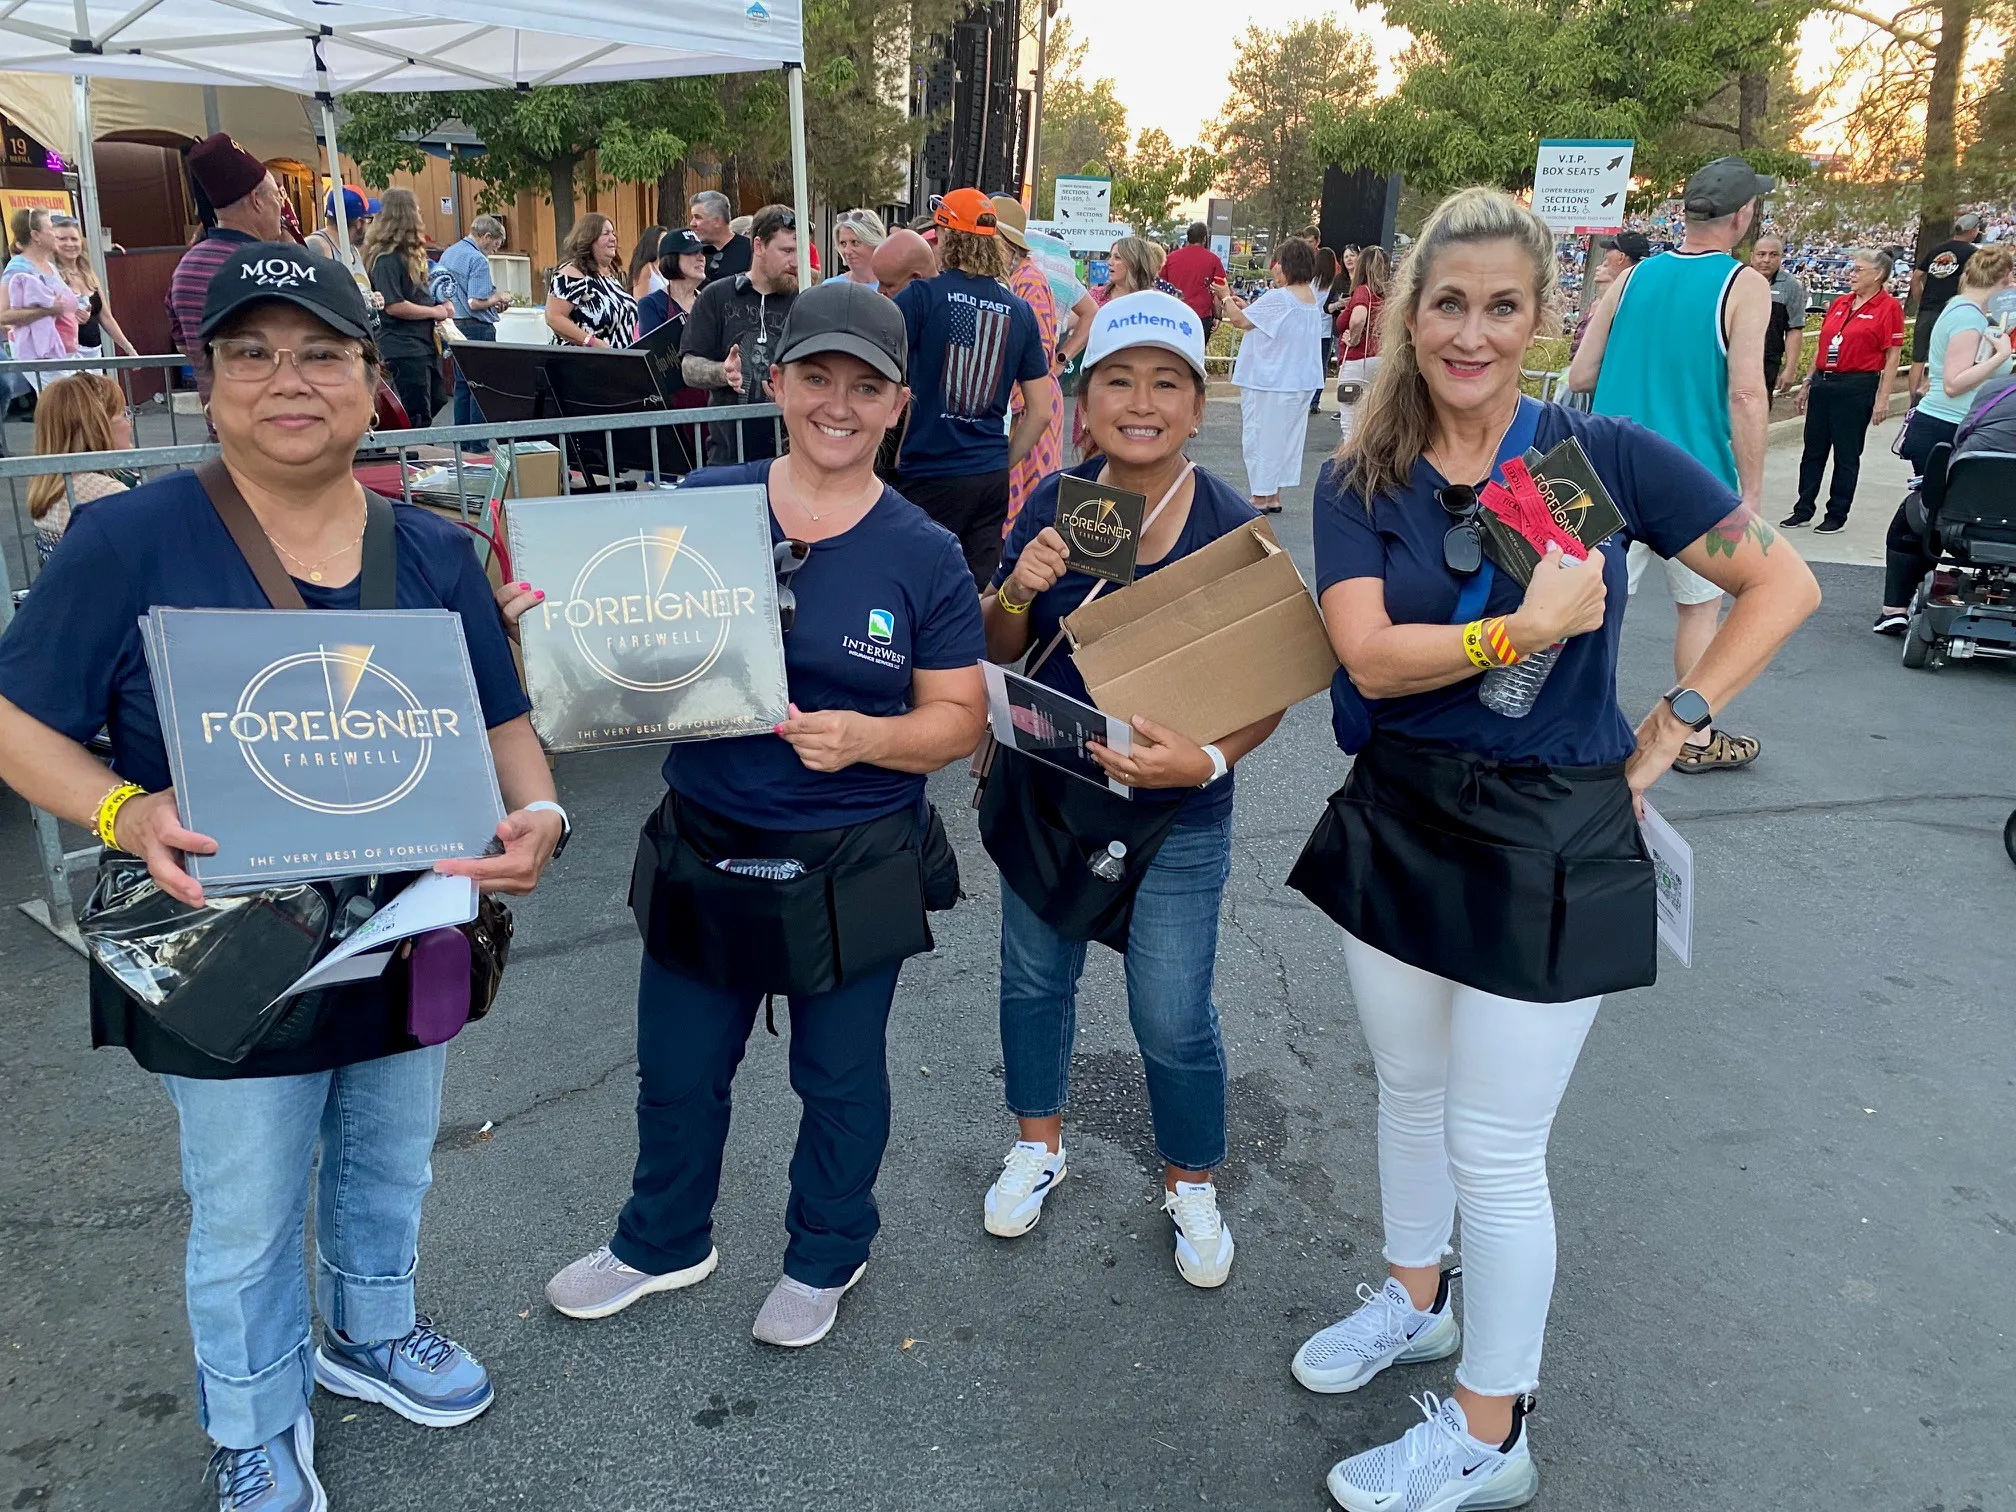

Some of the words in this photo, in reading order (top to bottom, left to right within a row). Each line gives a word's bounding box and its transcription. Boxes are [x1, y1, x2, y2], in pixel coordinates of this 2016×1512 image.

[10, 138, 27, 155] 19
[1558, 154, 1587, 163] V.I.P.
[1542, 167, 1564, 176] BOX
[1566, 167, 1600, 176] SEATS
[1541, 205, 1579, 214] 114-115,
[1544, 196, 1590, 204] SECTIONS
[1089, 228, 1124, 237] STATION
[240, 258, 318, 283] MOM
[947, 292, 977, 307] HOLD
[979, 299, 1012, 316] FAST
[1106, 312, 1177, 332] Anthem
[1505, 465, 1523, 491] TICKET
[1061, 513, 1132, 540] FOREIGNER
[541, 586, 756, 632] FOREIGNER
[606, 630, 703, 650] FAREWELL
[201, 708, 461, 744] FOREIGNER
[577, 730, 598, 740] THE
[603, 727, 631, 737] VERY
[636, 723, 662, 735] BEST
[667, 722, 682, 731] OF
[283, 749, 401, 768] FAREWELL
[249, 856, 276, 868] THE
[282, 853, 319, 865] VERY
[325, 850, 358, 862] BEST
[364, 848, 383, 858] OF
[389, 842, 466, 857] FOREIGNER
